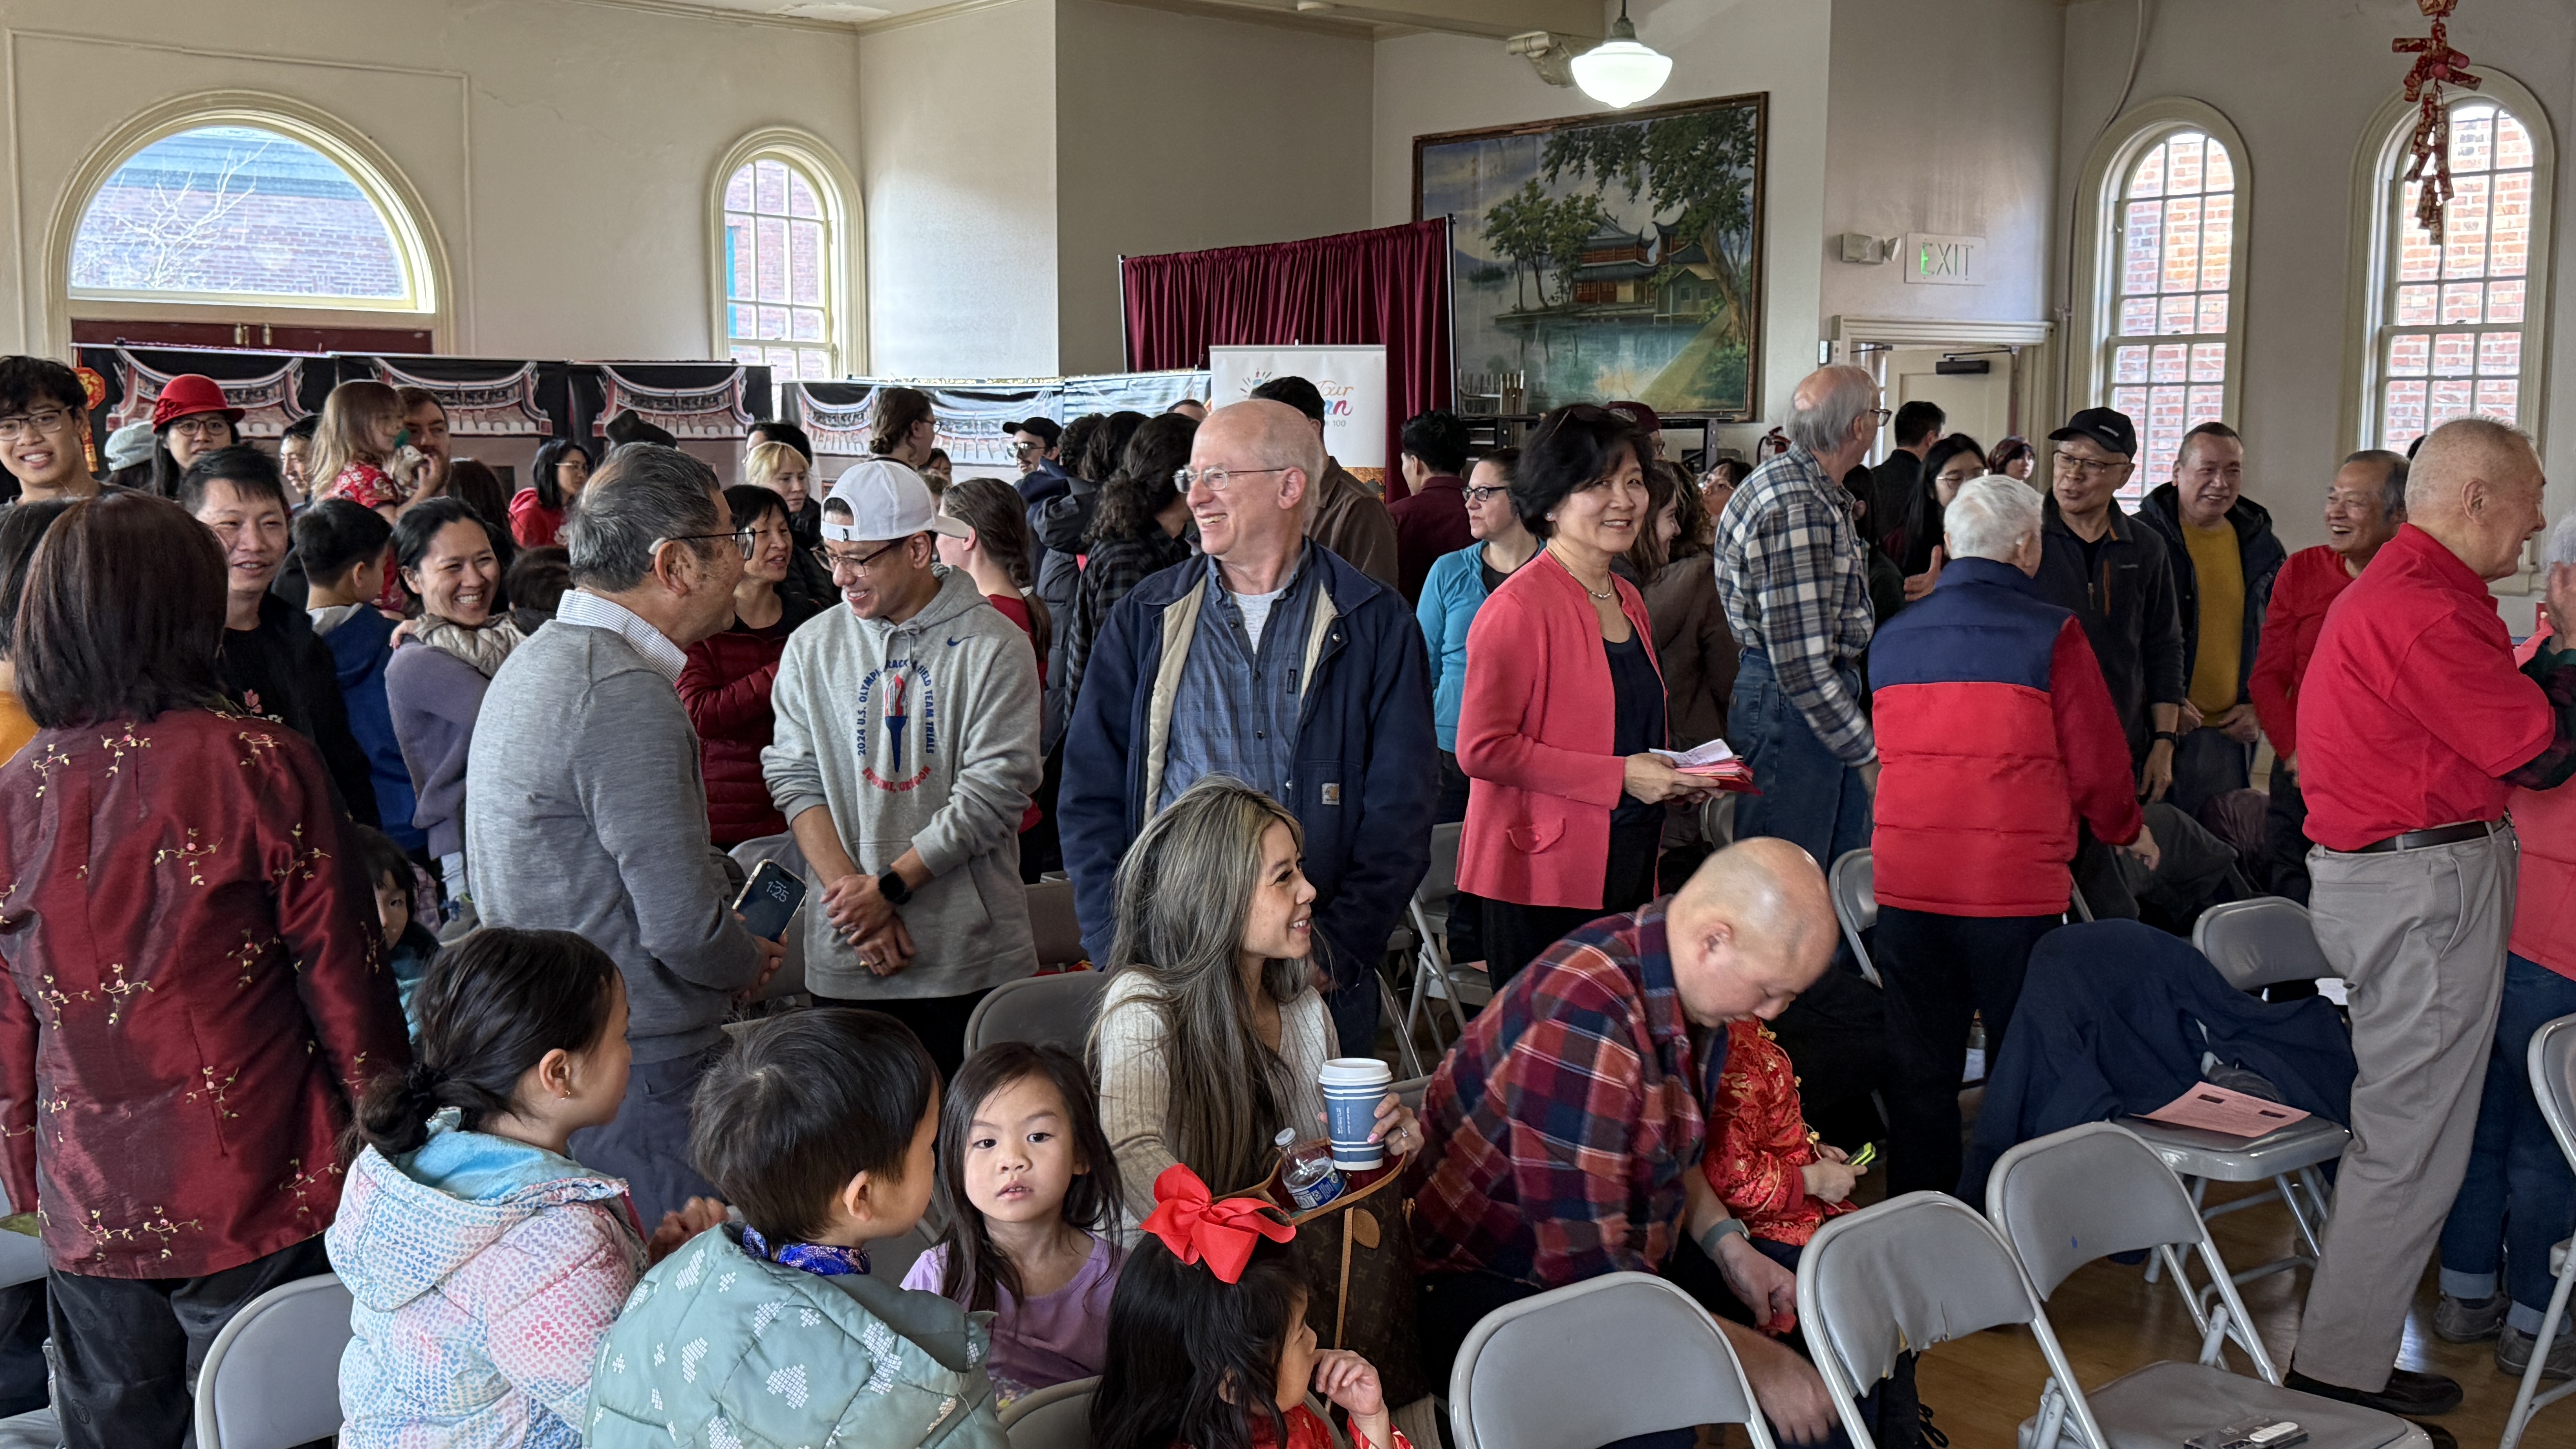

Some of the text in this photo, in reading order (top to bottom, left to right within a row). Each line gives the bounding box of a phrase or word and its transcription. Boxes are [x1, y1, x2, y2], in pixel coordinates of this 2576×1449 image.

[1920, 242, 1973, 276] EXIT
[884, 658, 909, 670] RACK
[859, 668, 883, 703] OLYMPI
[857, 707, 866, 725] U.S.
[925, 690, 934, 718] TEAM
[857, 729, 866, 756] 2024
[925, 721, 935, 754] TRIALS
[766, 881, 789, 902] 1:25
